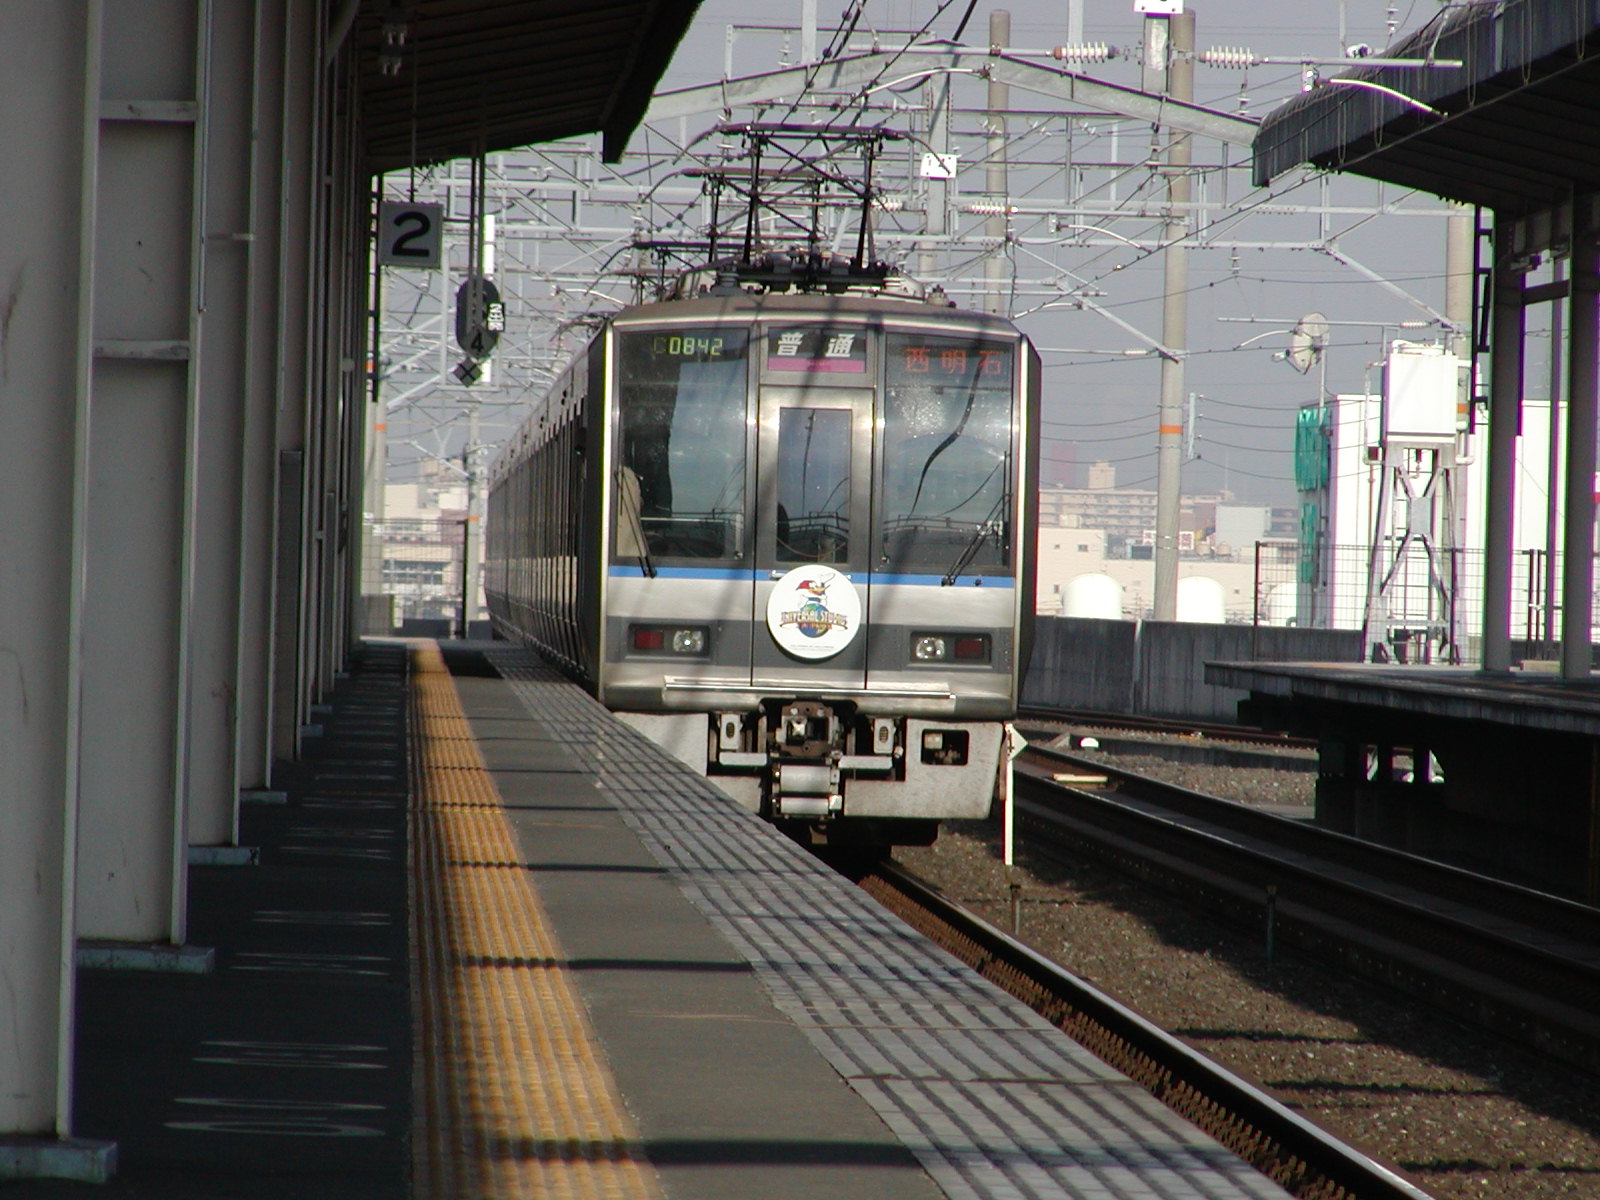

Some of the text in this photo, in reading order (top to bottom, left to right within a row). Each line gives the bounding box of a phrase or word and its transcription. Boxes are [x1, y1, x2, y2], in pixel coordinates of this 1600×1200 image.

[392, 211, 431, 257] 2
[904, 346, 1005, 375] 西明石
